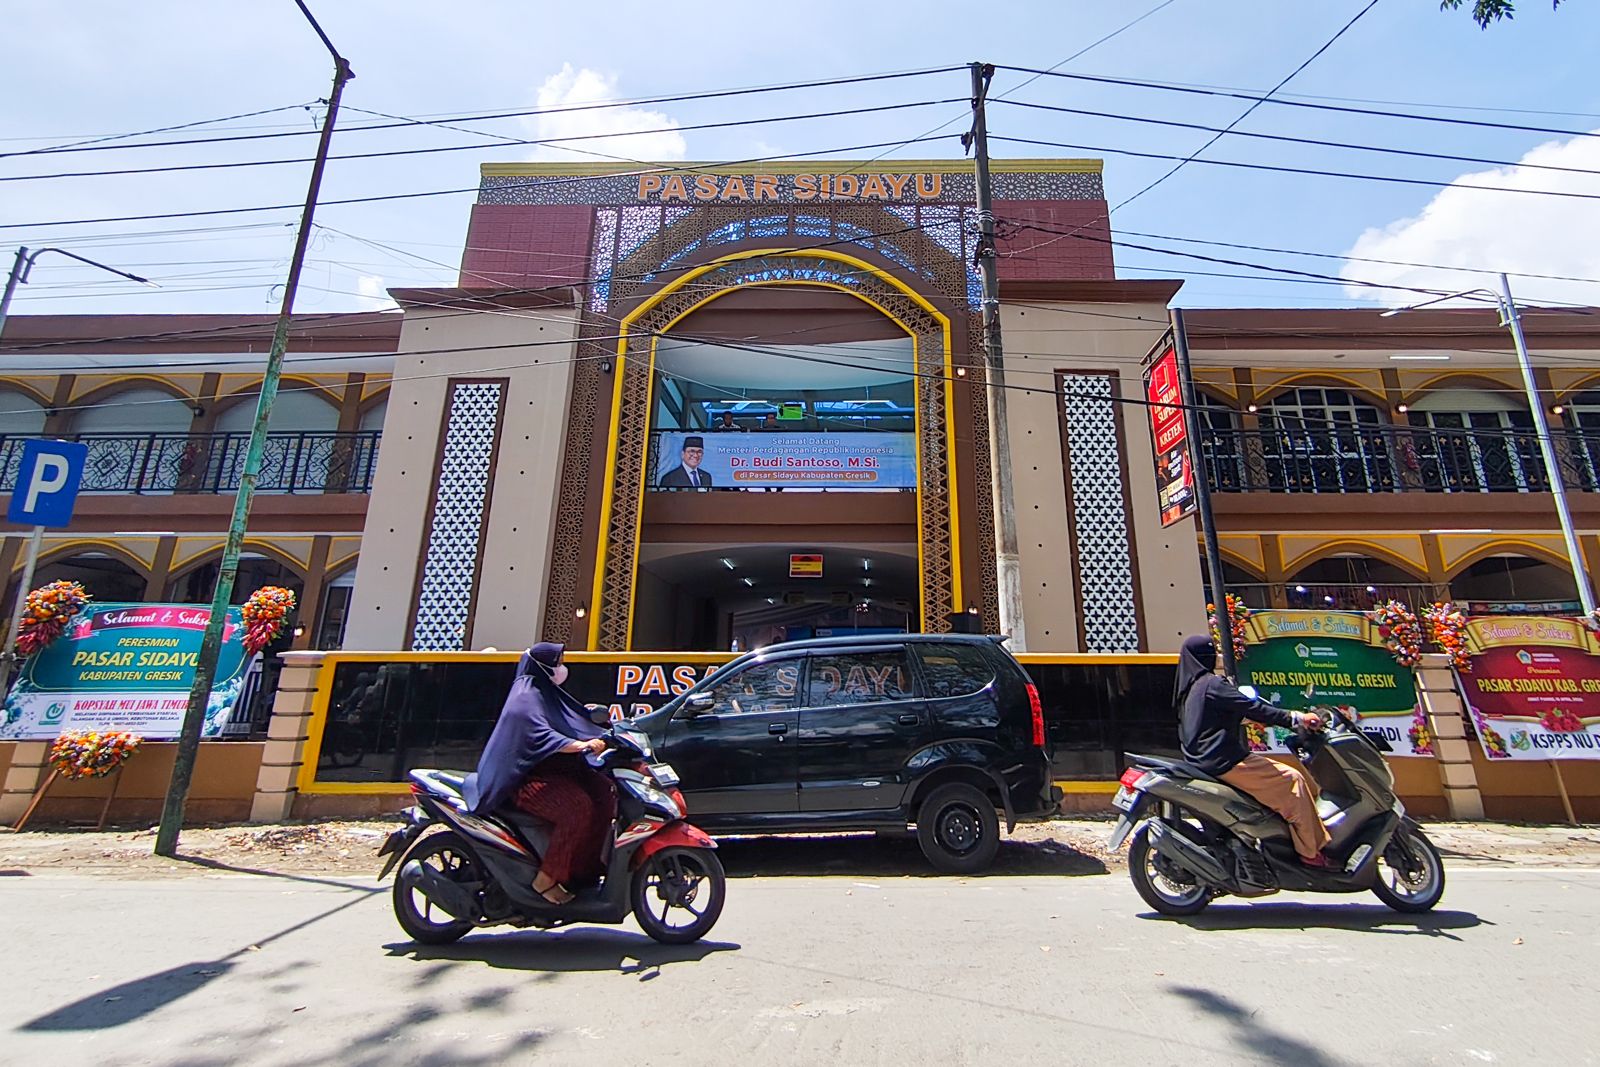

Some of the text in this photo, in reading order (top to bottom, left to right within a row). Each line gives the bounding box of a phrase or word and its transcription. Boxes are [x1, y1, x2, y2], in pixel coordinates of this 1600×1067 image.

[637, 173, 943, 201] PASAR SIDAYU
[772, 437, 840, 446] Selamat Datang
[1159, 421, 1183, 447] KRETEK
[718, 446, 894, 455] Menteri Perdagangan Republik Indonesia
[731, 457, 880, 469] Dr. Budi Santoso, M.Si.
[23, 452, 70, 513] P
[739, 472, 870, 481] di Pasar Sidayu Kabupaten Gresik
[103, 610, 210, 626] Selamat & Sukse
[1267, 616, 1308, 633] Selamat
[1311, 617, 1321, 631] &
[1480, 623, 1521, 640] Selamat
[1522, 623, 1533, 638] &
[117, 637, 180, 648] PERESMIAN
[72, 651, 135, 667] PASAR
[79, 671, 184, 681] KABUPATEN GRESIK
[1251, 671, 1397, 688] PASAR SIDAYU KAB. GRESIK
[1477, 678, 1514, 693] PASAR
[1512, 678, 1553, 693] SIDAYU
[1553, 678, 1582, 693] KAB.
[73, 699, 117, 711] KOPSYAH
[136, 699, 159, 711] JAWA
[1530, 733, 1573, 749] KSPPS
[1572, 733, 1594, 749] NU
